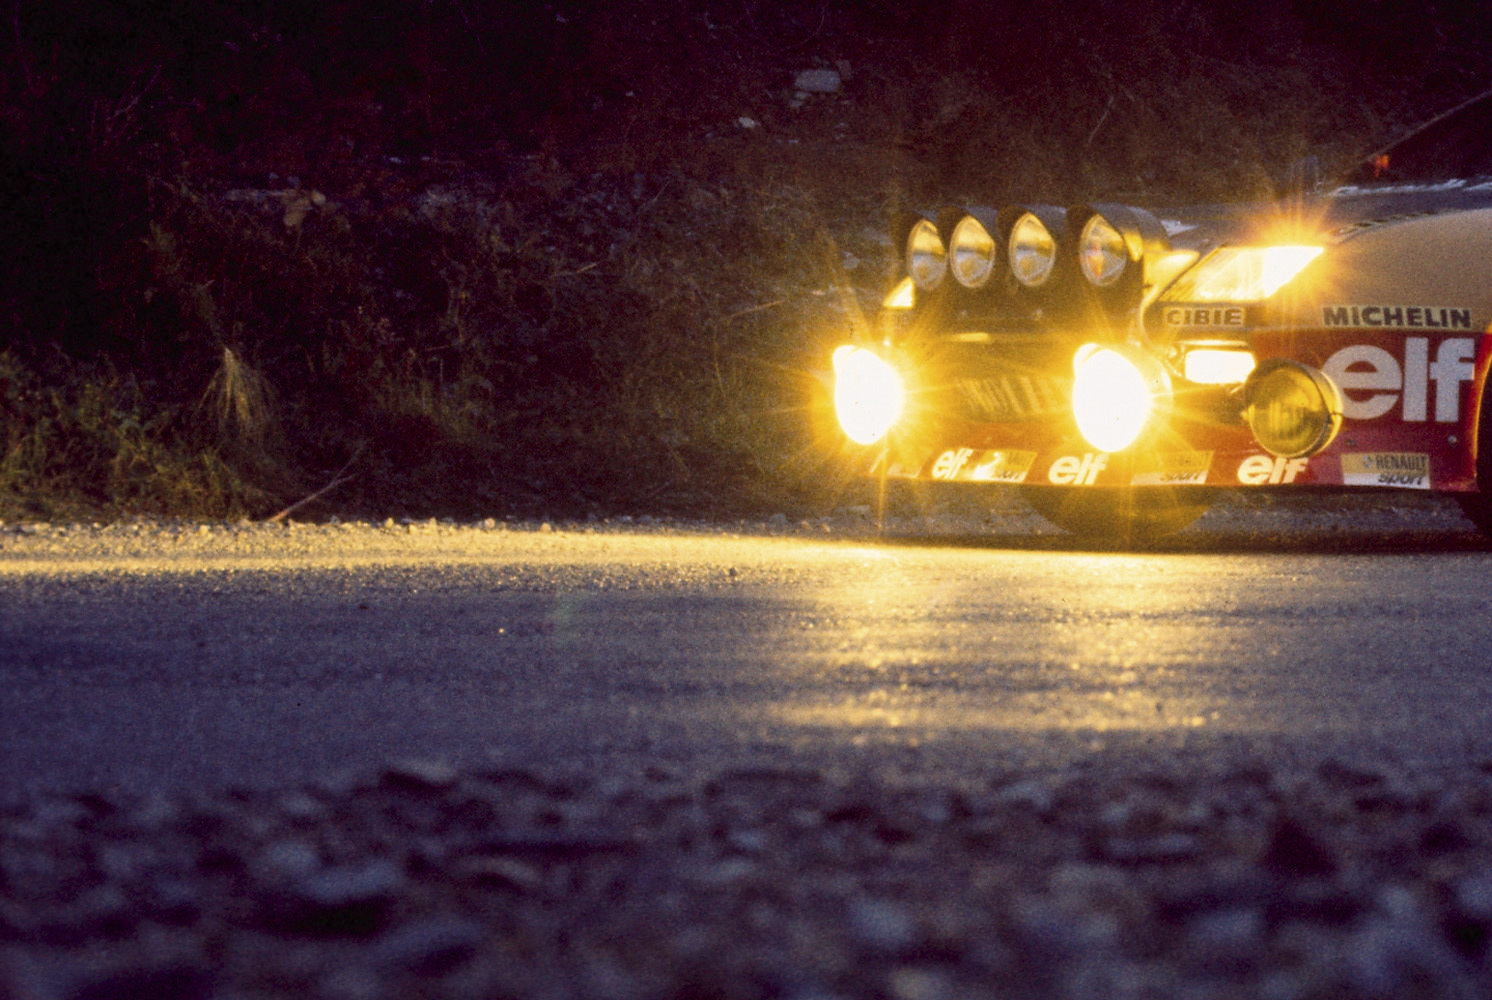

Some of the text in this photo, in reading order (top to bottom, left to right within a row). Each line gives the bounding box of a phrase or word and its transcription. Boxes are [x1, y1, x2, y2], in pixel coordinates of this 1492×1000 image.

[1165, 307, 1244, 327] CIBIE
[1323, 306, 1472, 328] MICHELIN
[1321, 336, 1475, 422] elf
[932, 447, 973, 480] elf
[1048, 452, 1109, 486] elf
[1237, 454, 1310, 485] elf
[1375, 454, 1427, 471] RENAULT
